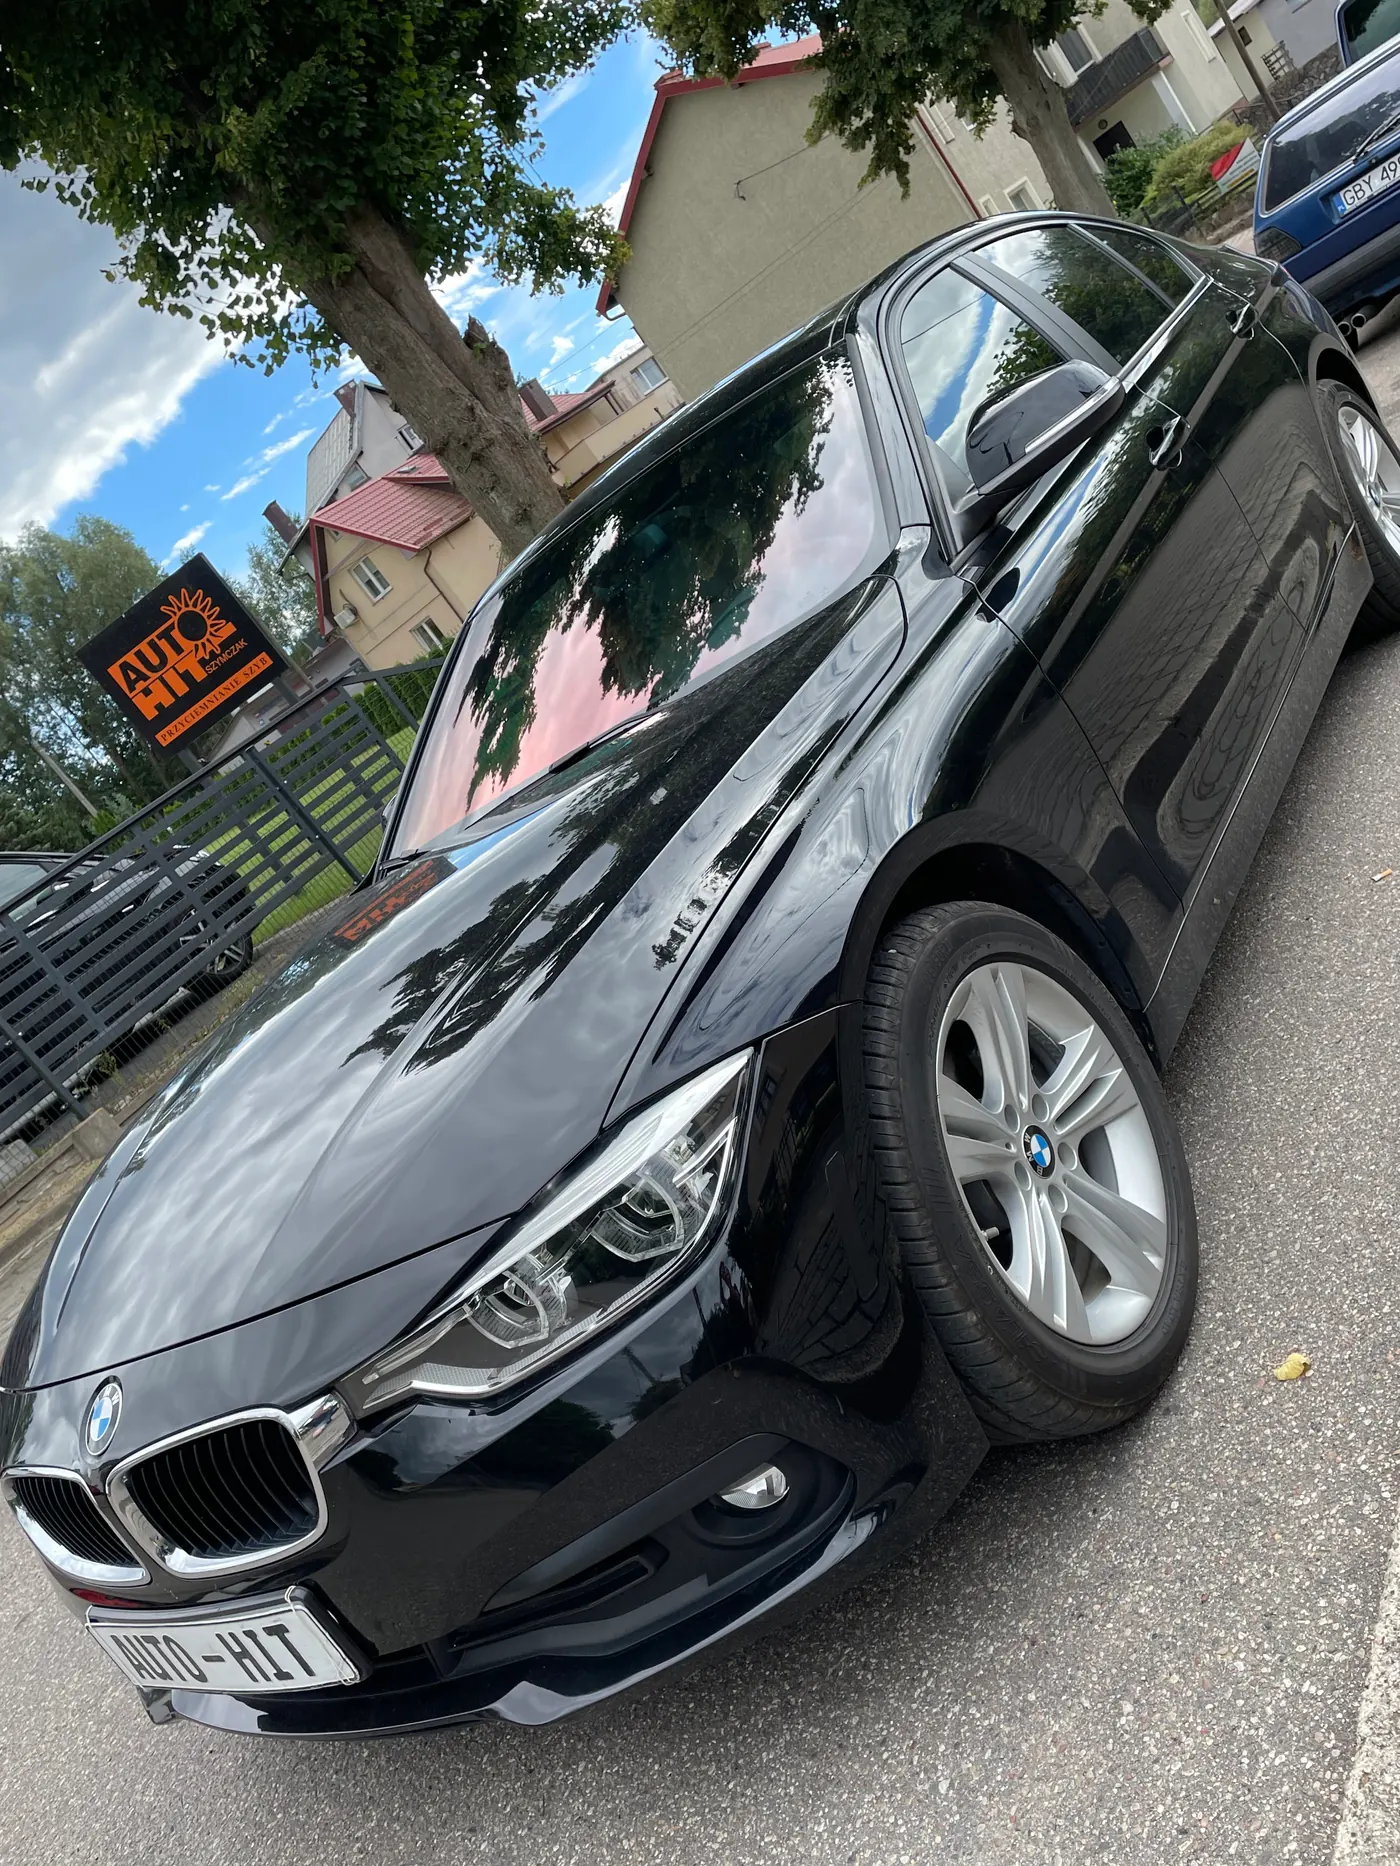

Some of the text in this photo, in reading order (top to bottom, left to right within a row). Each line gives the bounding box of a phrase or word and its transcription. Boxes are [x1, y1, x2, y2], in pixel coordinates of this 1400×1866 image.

[1343, 175, 1373, 206] GBY
[205, 638, 248, 674] SZYMCZAK
[132, 652, 208, 721] HIT
[160, 657, 268, 742] PRZYCIEMNIANIE SZYB
